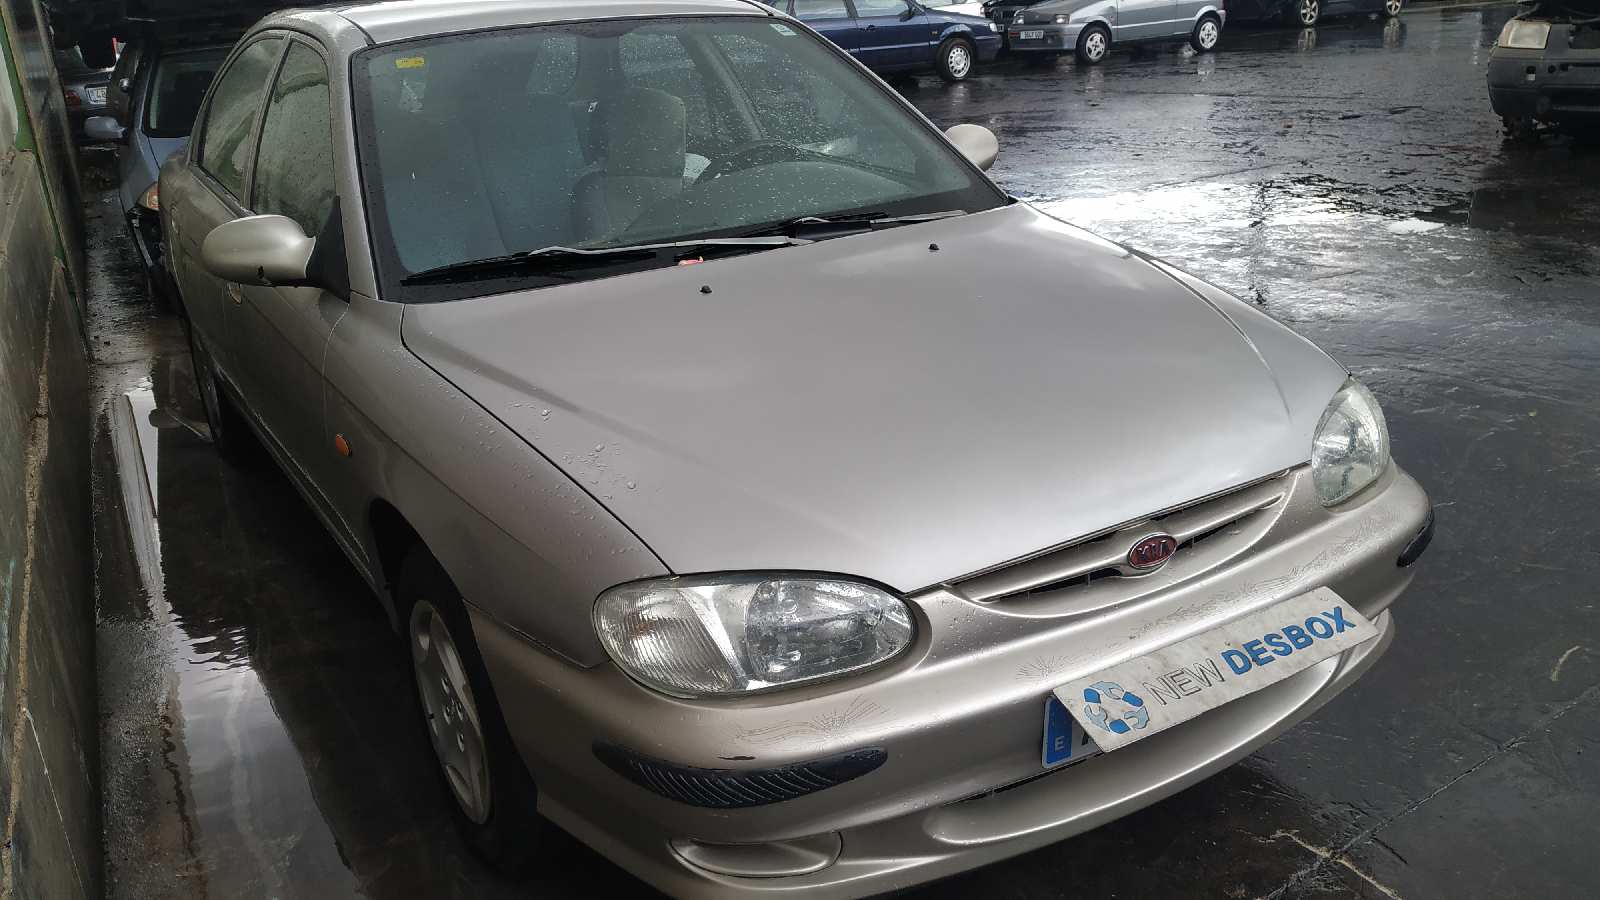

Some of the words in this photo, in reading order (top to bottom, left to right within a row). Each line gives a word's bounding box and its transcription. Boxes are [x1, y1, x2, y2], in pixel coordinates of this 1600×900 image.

[1135, 538, 1170, 563] KIA
[1142, 657, 1226, 705] NEW
[1220, 605, 1357, 676] DESBOX
[1055, 735, 1065, 751] E
